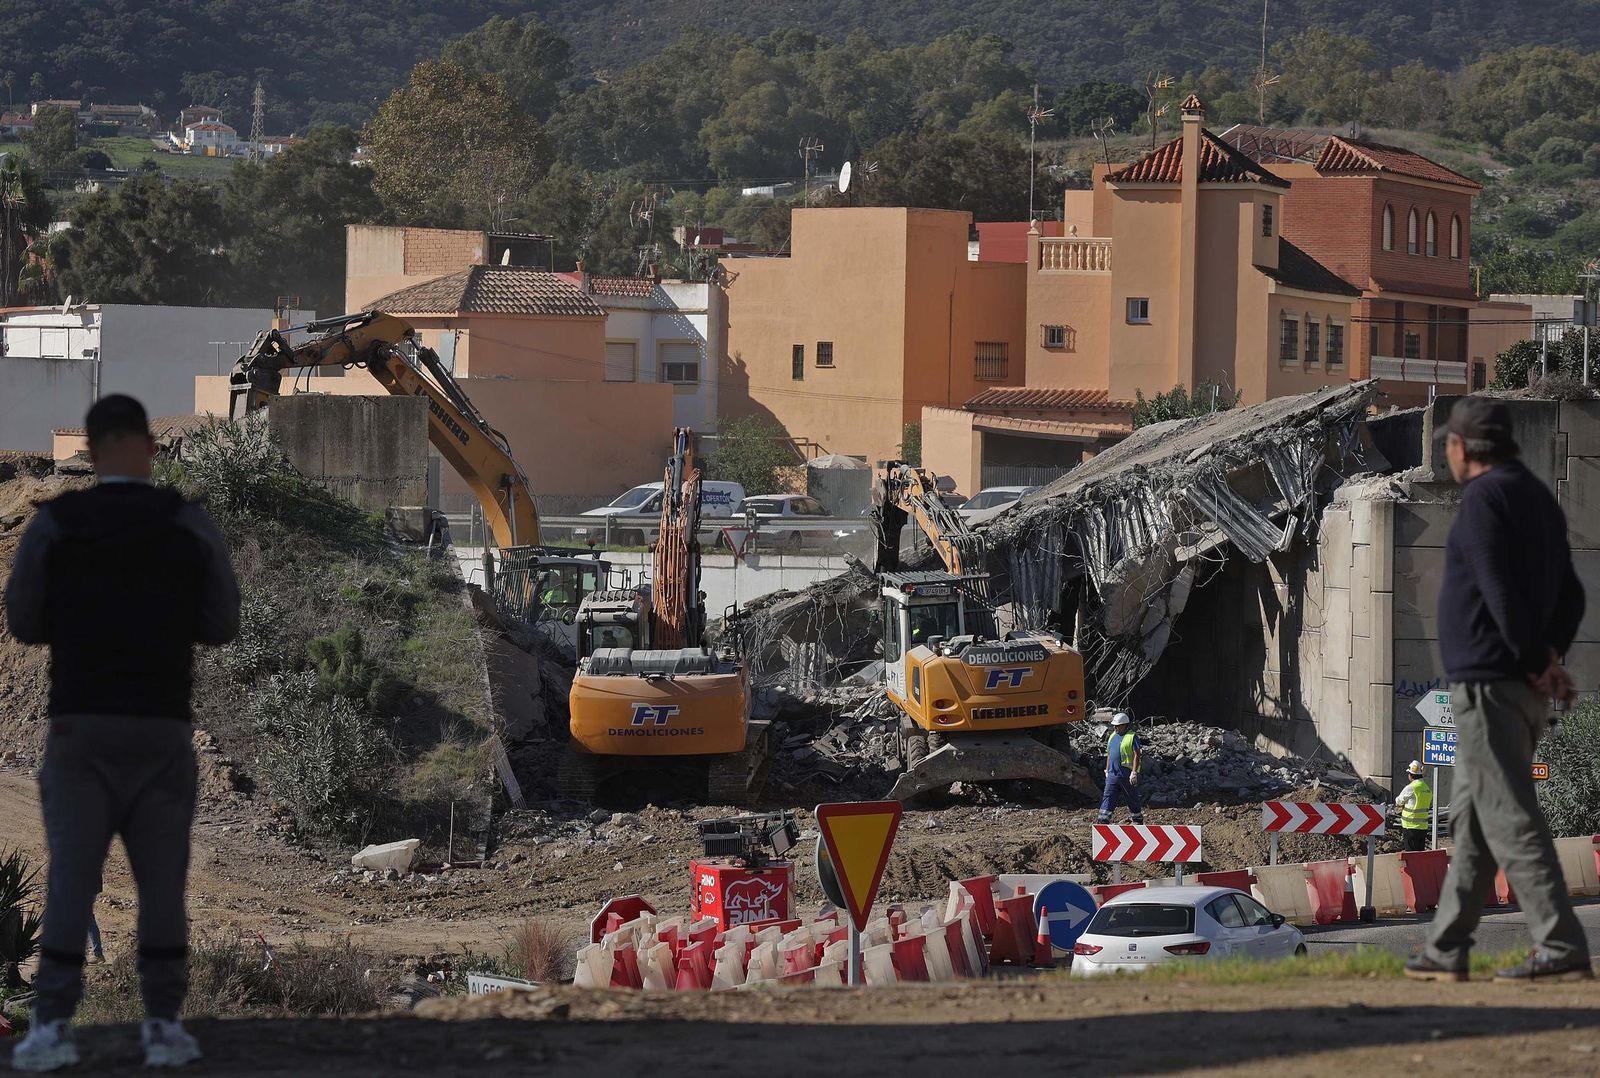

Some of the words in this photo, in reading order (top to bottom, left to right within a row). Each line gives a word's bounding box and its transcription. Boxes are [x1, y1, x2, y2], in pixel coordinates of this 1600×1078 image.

[968, 650, 1045, 665] DEMOLICIONES
[984, 666, 1034, 690] FT
[631, 702, 680, 726] FT
[971, 704, 1049, 721] LIEBHERR
[608, 727, 704, 737] DEMOLICIONES
[1426, 742, 1441, 751] San
[1431, 752, 1456, 764] Málag
[1532, 767, 1546, 776] 40
[701, 874, 715, 887] RINO
